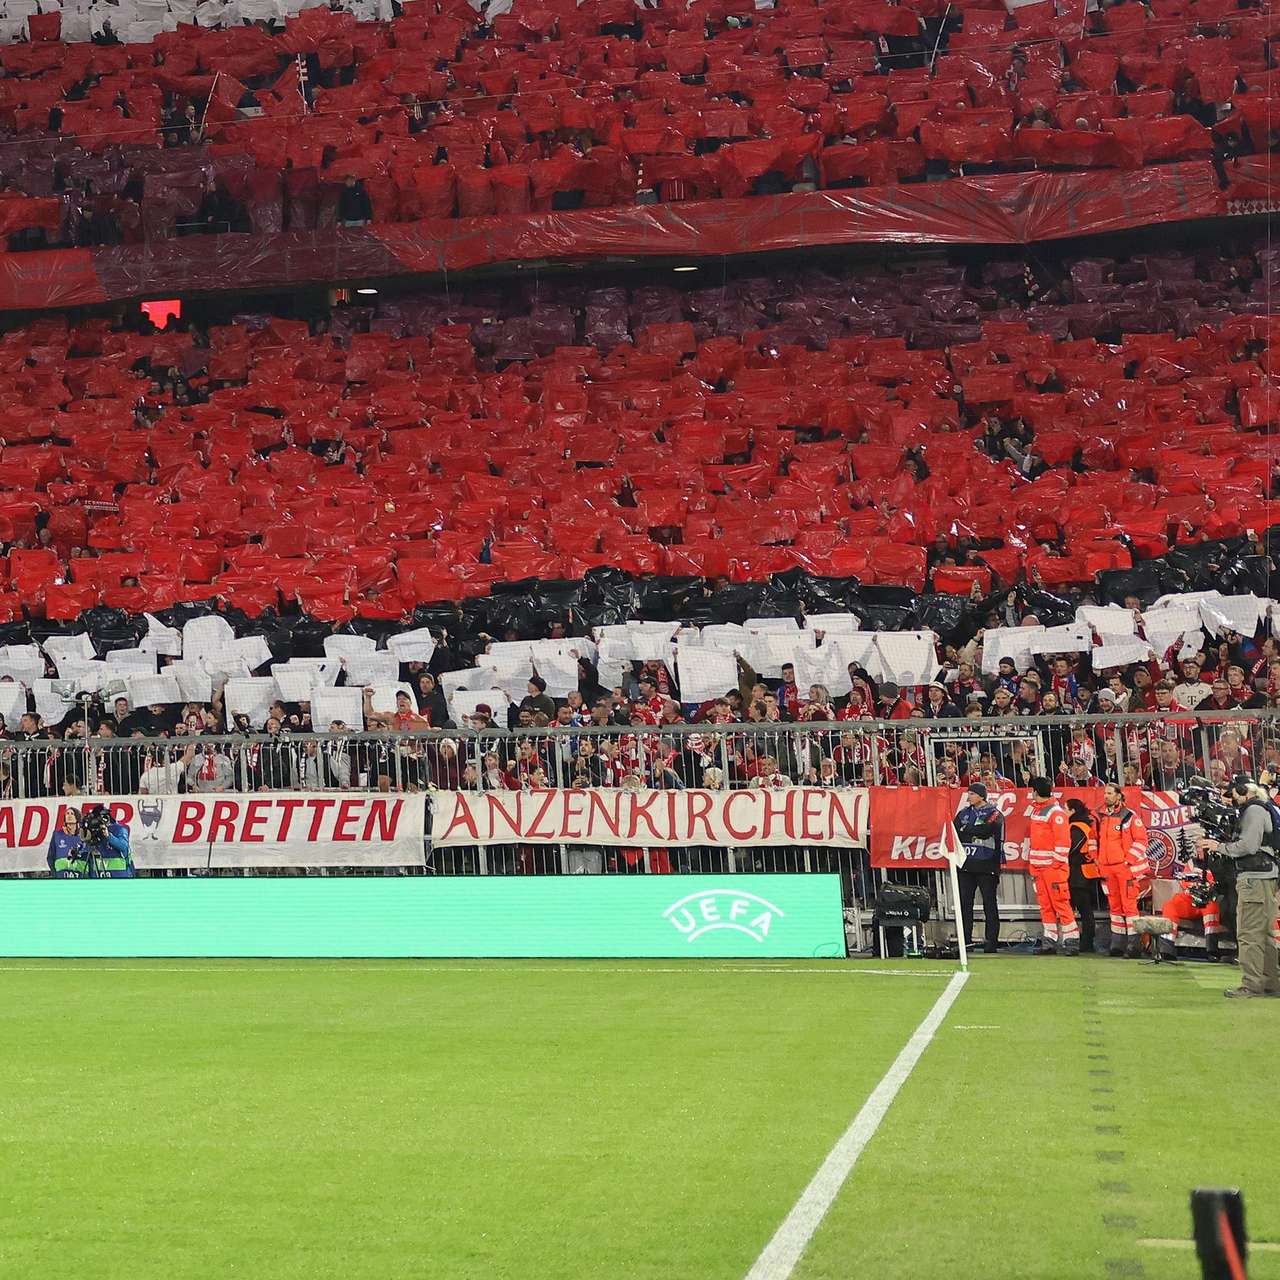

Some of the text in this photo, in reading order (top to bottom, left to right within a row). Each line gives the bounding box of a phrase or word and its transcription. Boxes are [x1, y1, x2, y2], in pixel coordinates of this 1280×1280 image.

[172, 798, 406, 844] BRETTEN
[441, 788, 863, 842] ANZENKIRCHEN
[669, 897, 773, 937] UEFA
